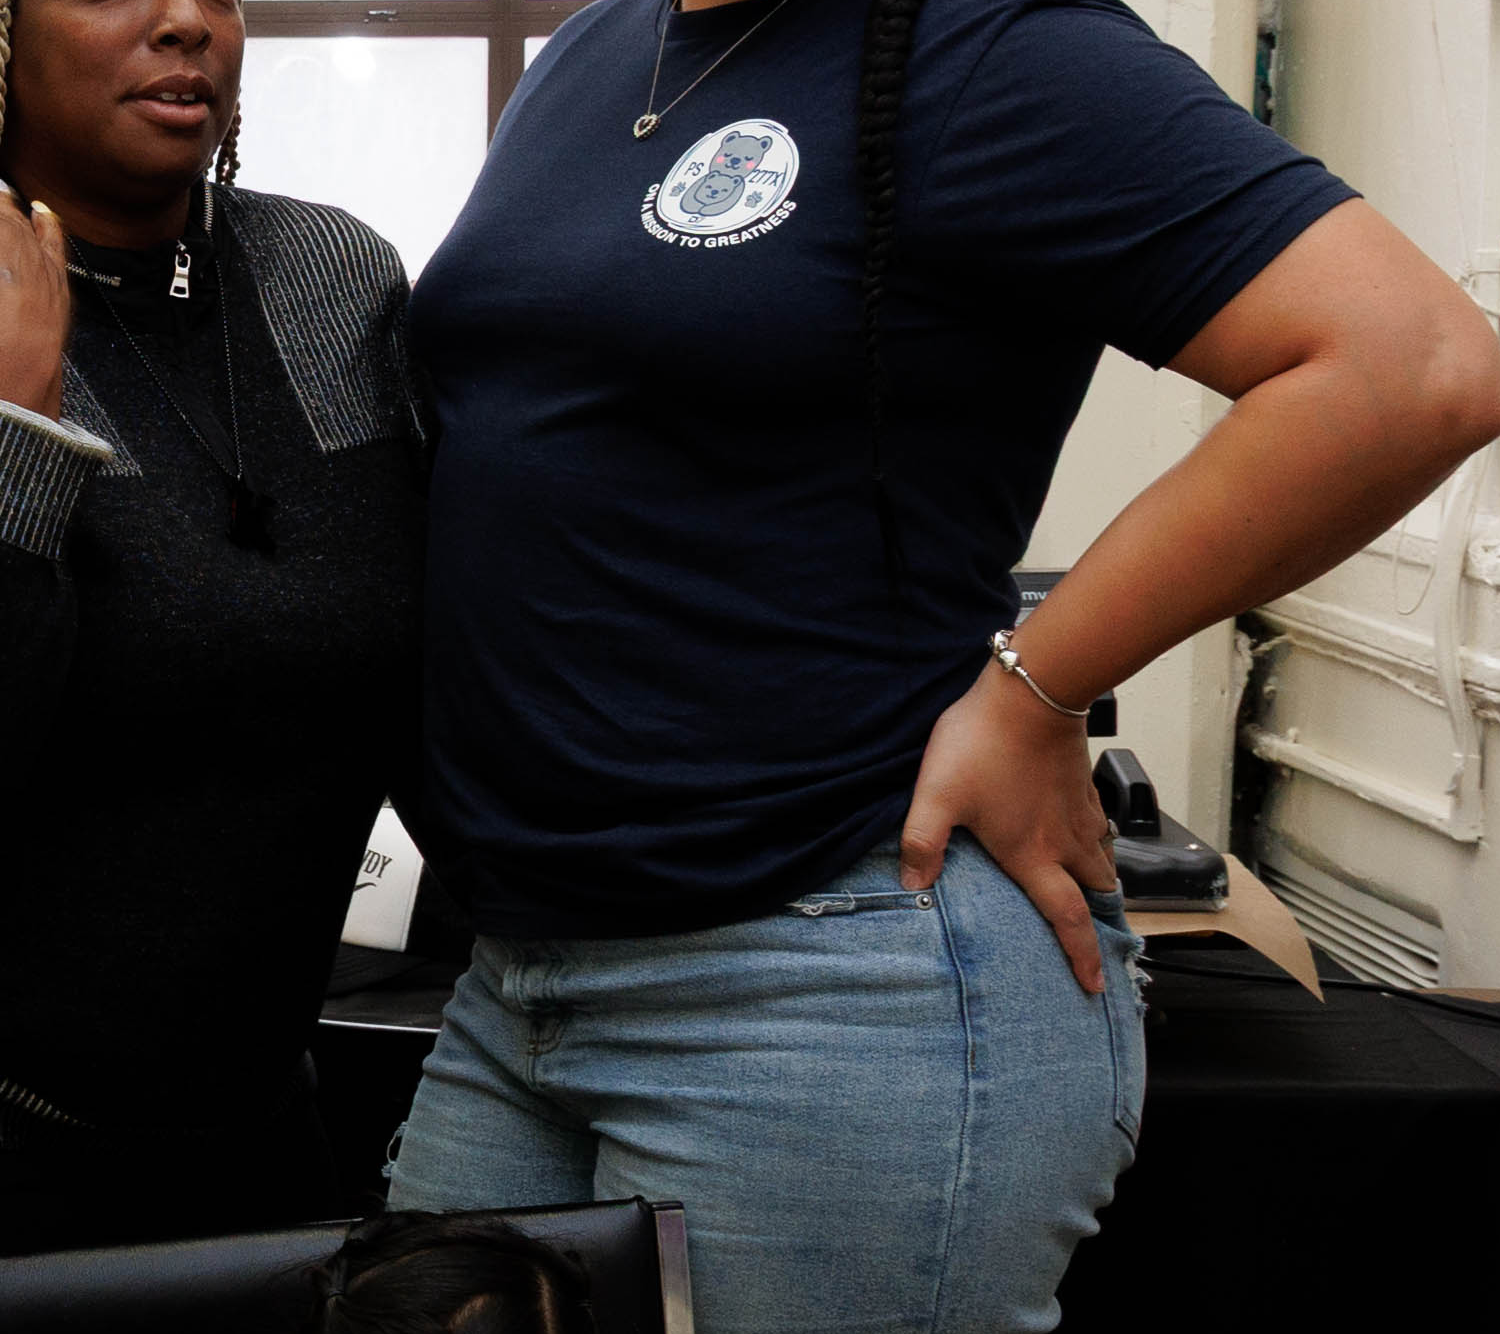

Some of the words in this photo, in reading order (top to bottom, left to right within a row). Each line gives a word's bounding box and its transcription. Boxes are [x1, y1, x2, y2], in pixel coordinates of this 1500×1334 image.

[684, 161, 705, 177] PS
[644, 183, 660, 201] ON
[641, 203, 650, 213] A
[640, 212, 678, 244] MISSION
[704, 200, 798, 248] GREATNESS
[679, 235, 701, 248] TO
